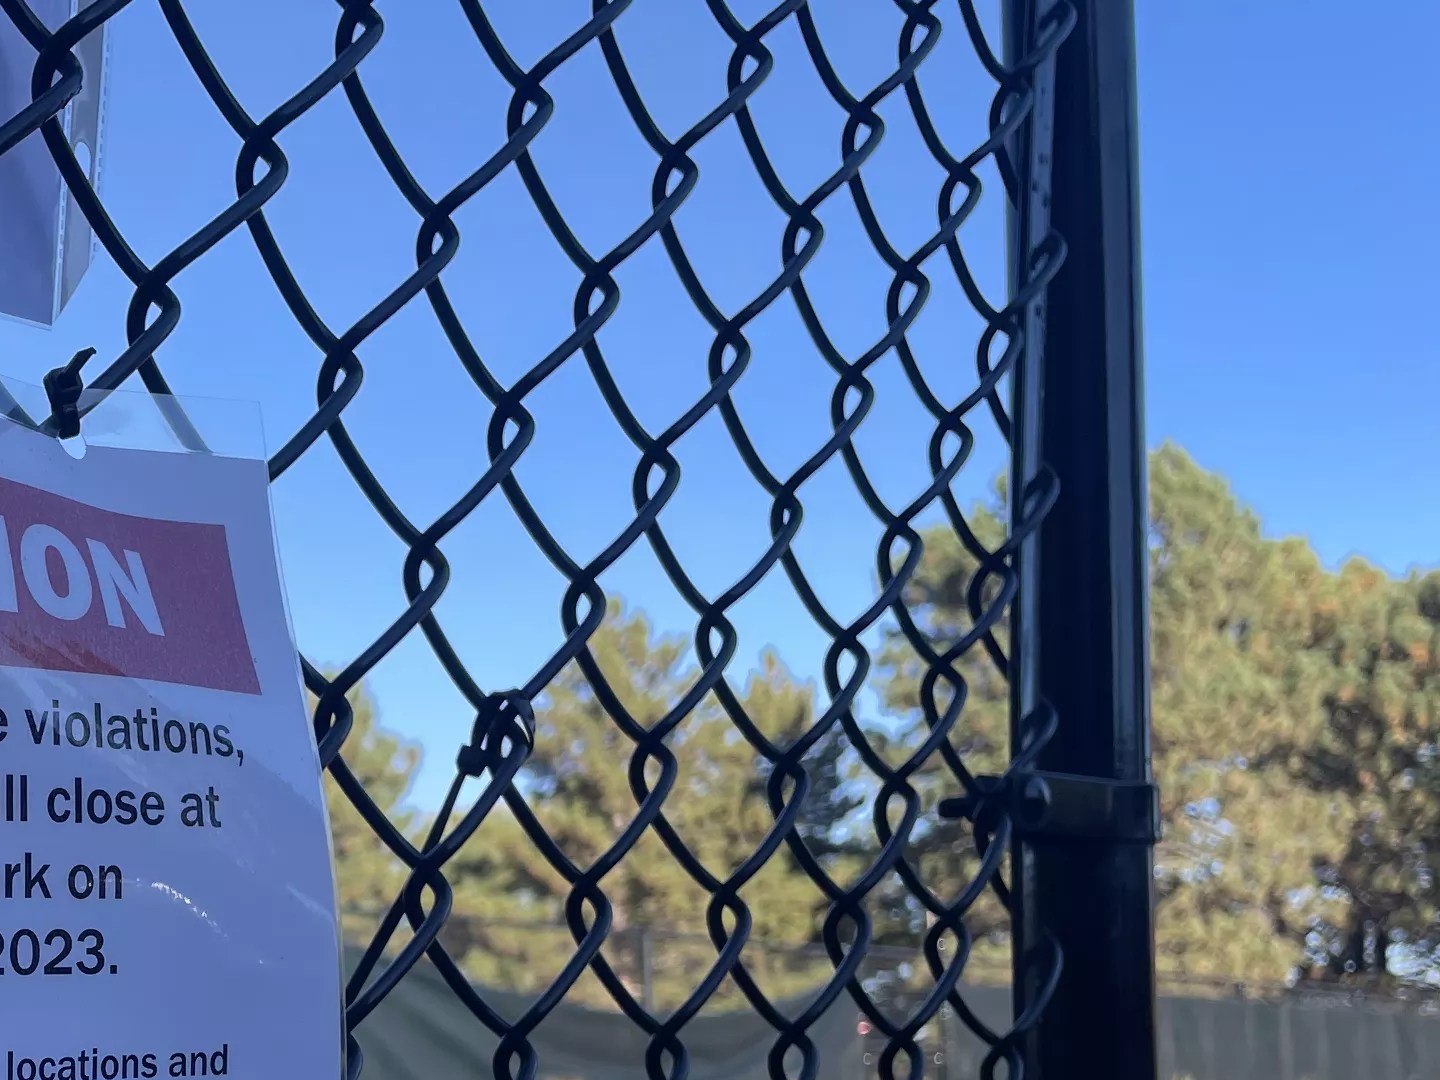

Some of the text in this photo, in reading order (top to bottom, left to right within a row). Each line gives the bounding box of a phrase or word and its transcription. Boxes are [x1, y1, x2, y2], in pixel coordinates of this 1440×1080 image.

[25, 703, 243, 766] violations,
[47, 777, 164, 825] close
[181, 786, 221, 828] at
[68, 865, 122, 899] on
[169, 1044, 228, 1077] and
